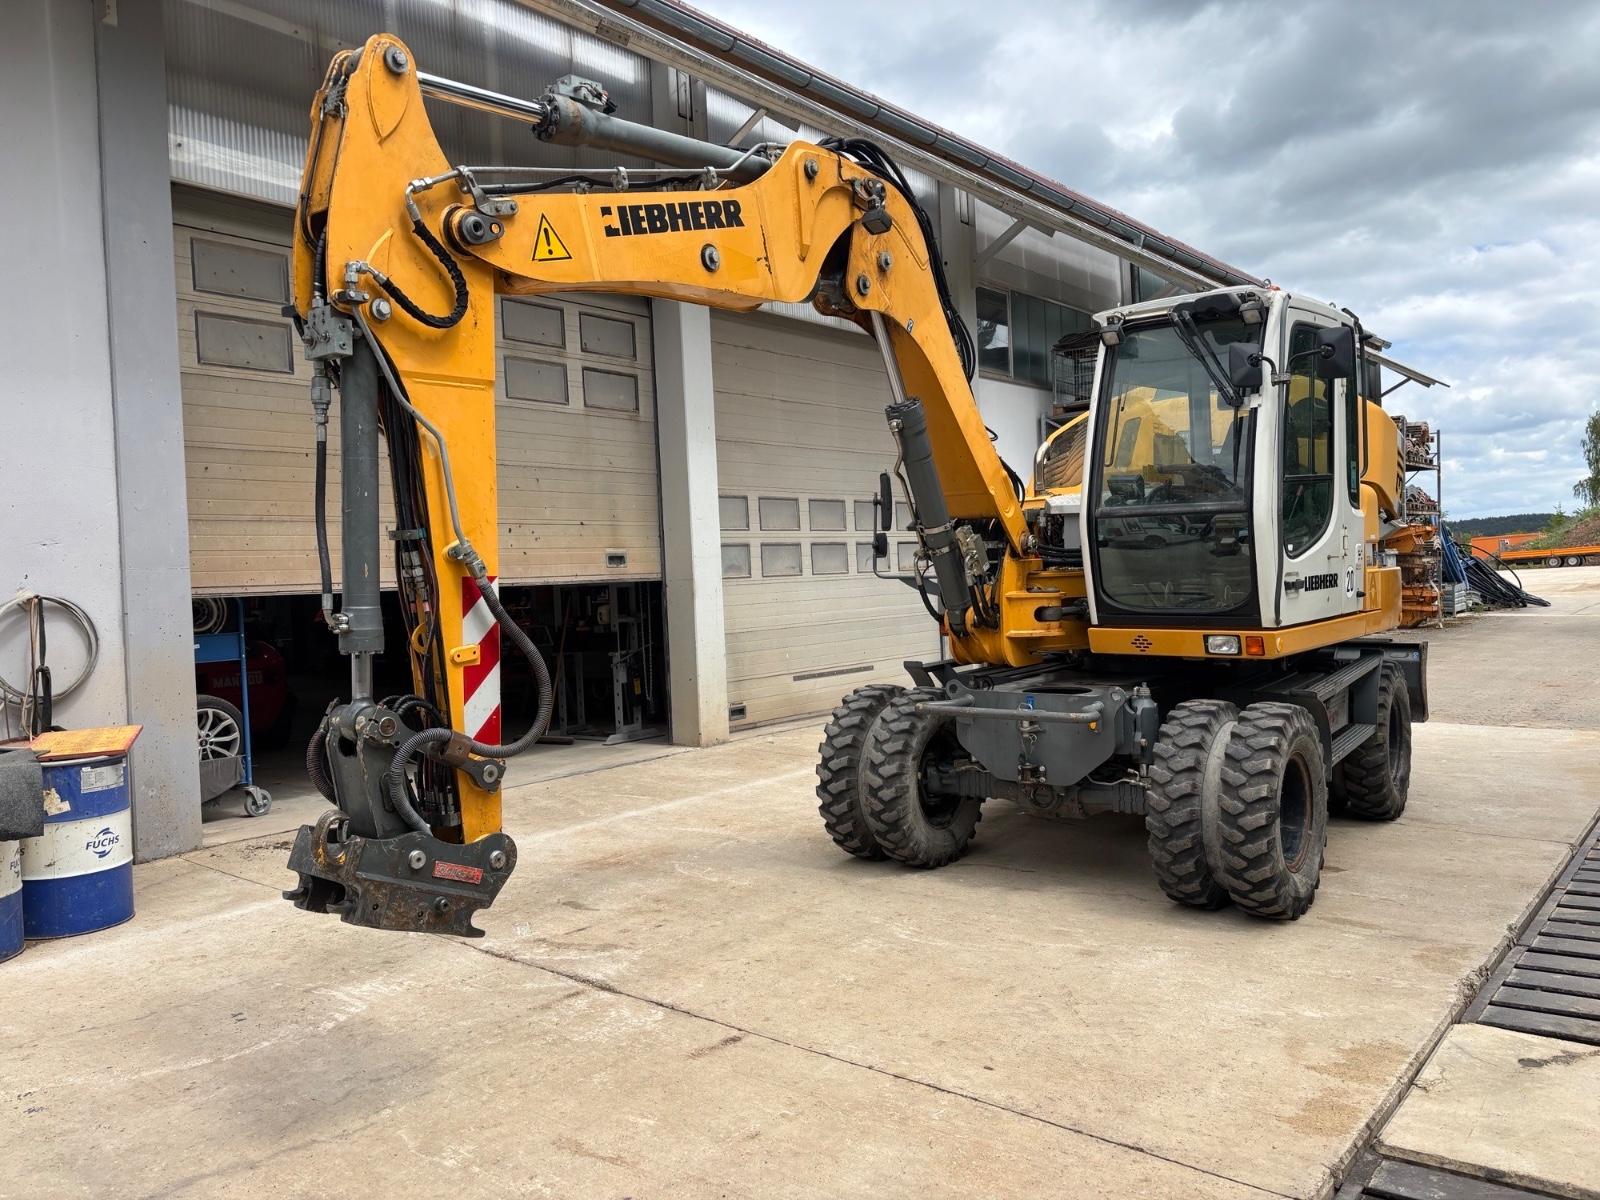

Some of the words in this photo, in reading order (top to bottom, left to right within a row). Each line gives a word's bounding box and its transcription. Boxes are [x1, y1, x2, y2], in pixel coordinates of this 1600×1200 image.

[1304, 572, 1339, 592] LIEBHERR
[1346, 570, 1354, 593] 20
[85, 834, 120, 850] FUCHS
